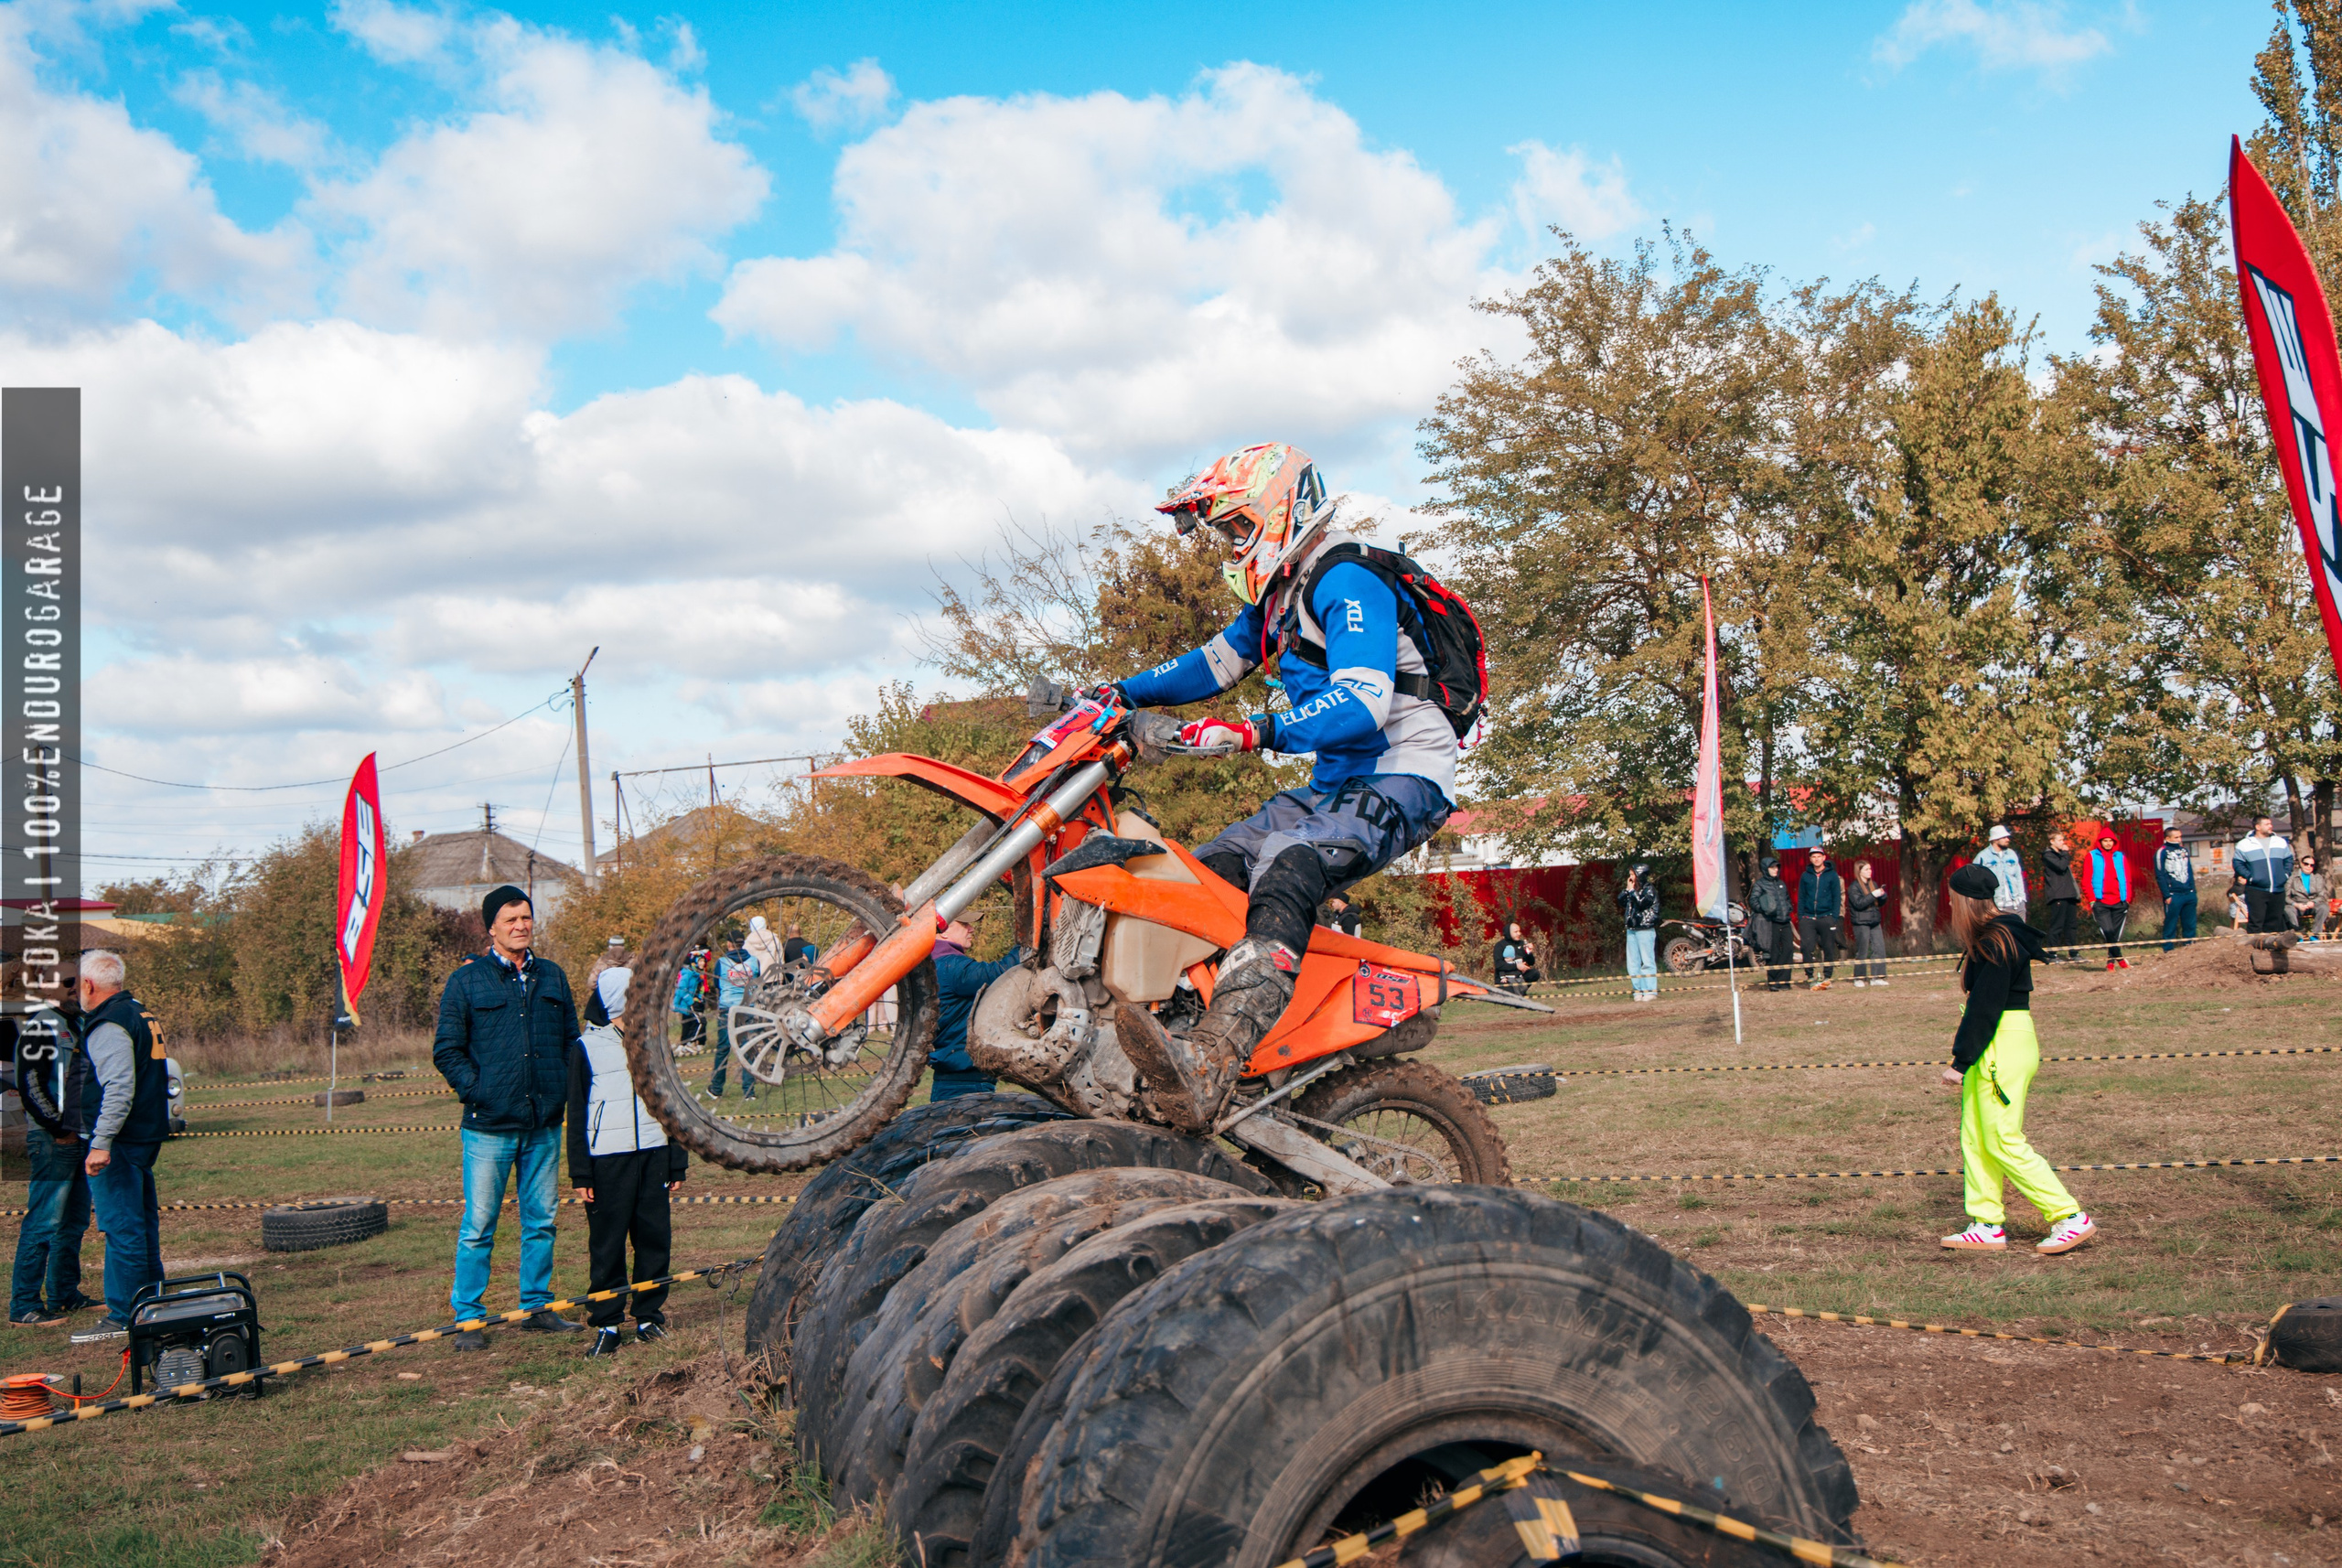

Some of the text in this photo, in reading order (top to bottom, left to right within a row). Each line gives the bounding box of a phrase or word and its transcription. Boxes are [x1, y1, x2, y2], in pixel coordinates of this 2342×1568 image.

[1344, 597, 1364, 633] FOX
[1152, 658, 1179, 678] FOX
[1369, 982, 1404, 1011] 53
[88, 1332, 113, 1342] crocs
